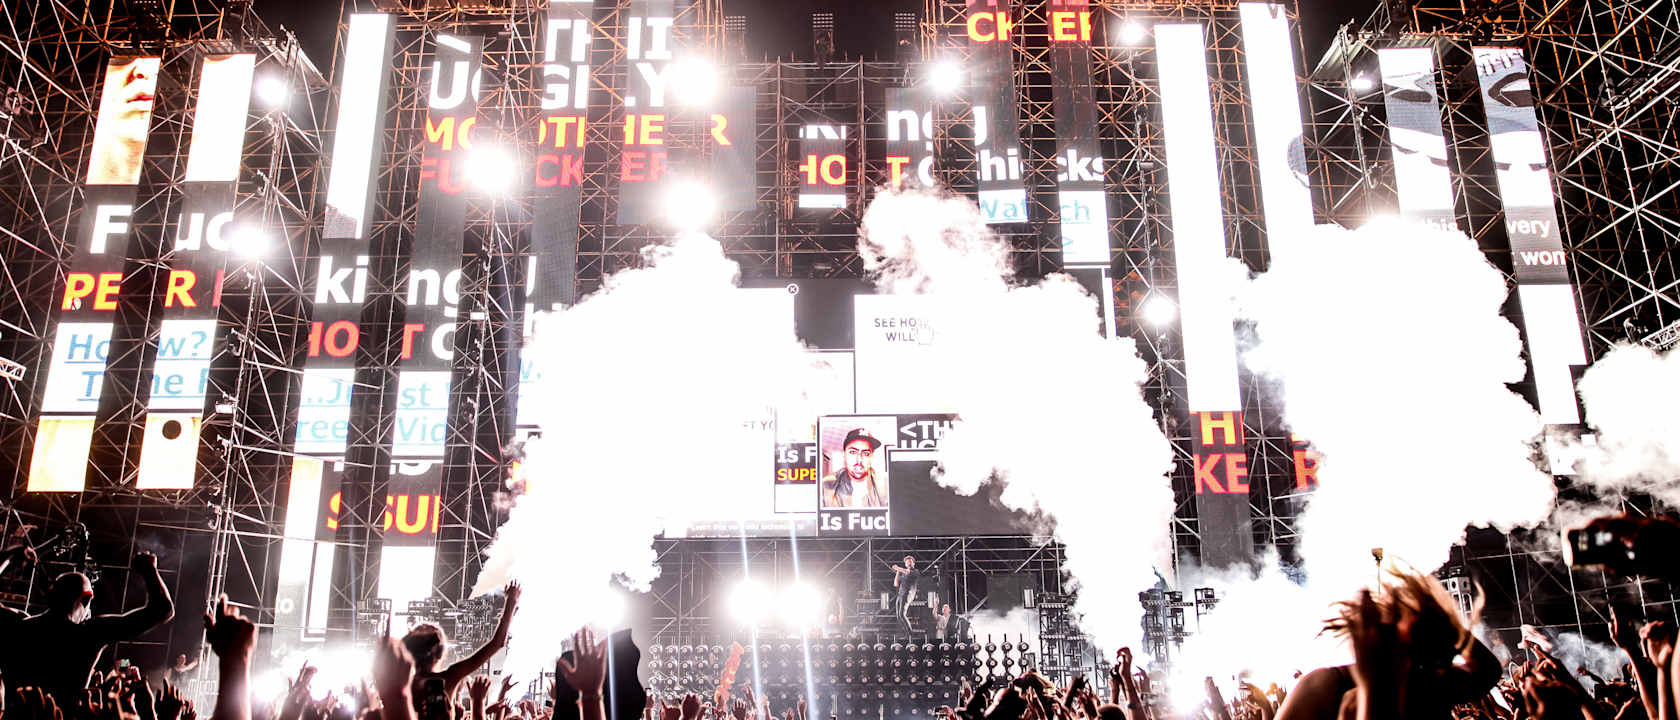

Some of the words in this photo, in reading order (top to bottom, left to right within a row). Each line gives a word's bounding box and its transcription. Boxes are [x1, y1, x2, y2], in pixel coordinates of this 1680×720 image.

[90, 205, 133, 254] F
[164, 269, 197, 308] R
[315, 256, 368, 304] ki
[874, 317, 896, 328] SEE
[886, 331, 915, 342] WILL
[777, 446, 799, 464] Is
[820, 512, 842, 531] Is
